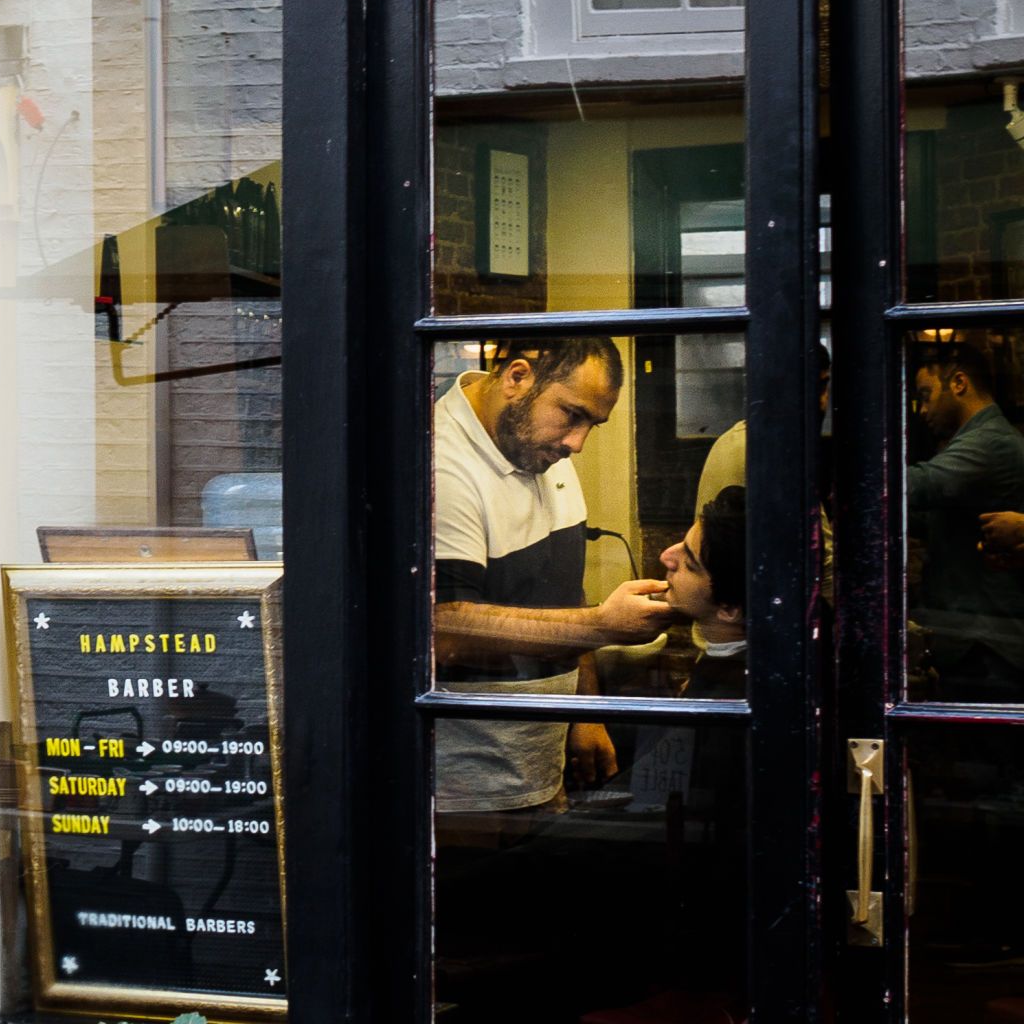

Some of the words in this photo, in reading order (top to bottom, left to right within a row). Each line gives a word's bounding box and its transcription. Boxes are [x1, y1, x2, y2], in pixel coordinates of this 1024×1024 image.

[79, 633, 217, 654] HAMPSTEAD
[107, 678, 195, 698] BARBER
[48, 775, 127, 797] SATURDAY
[51, 813, 110, 835] SUNDAY
[77, 911, 176, 932] TRADITIONAL
[185, 917, 256, 935] BARBERS
